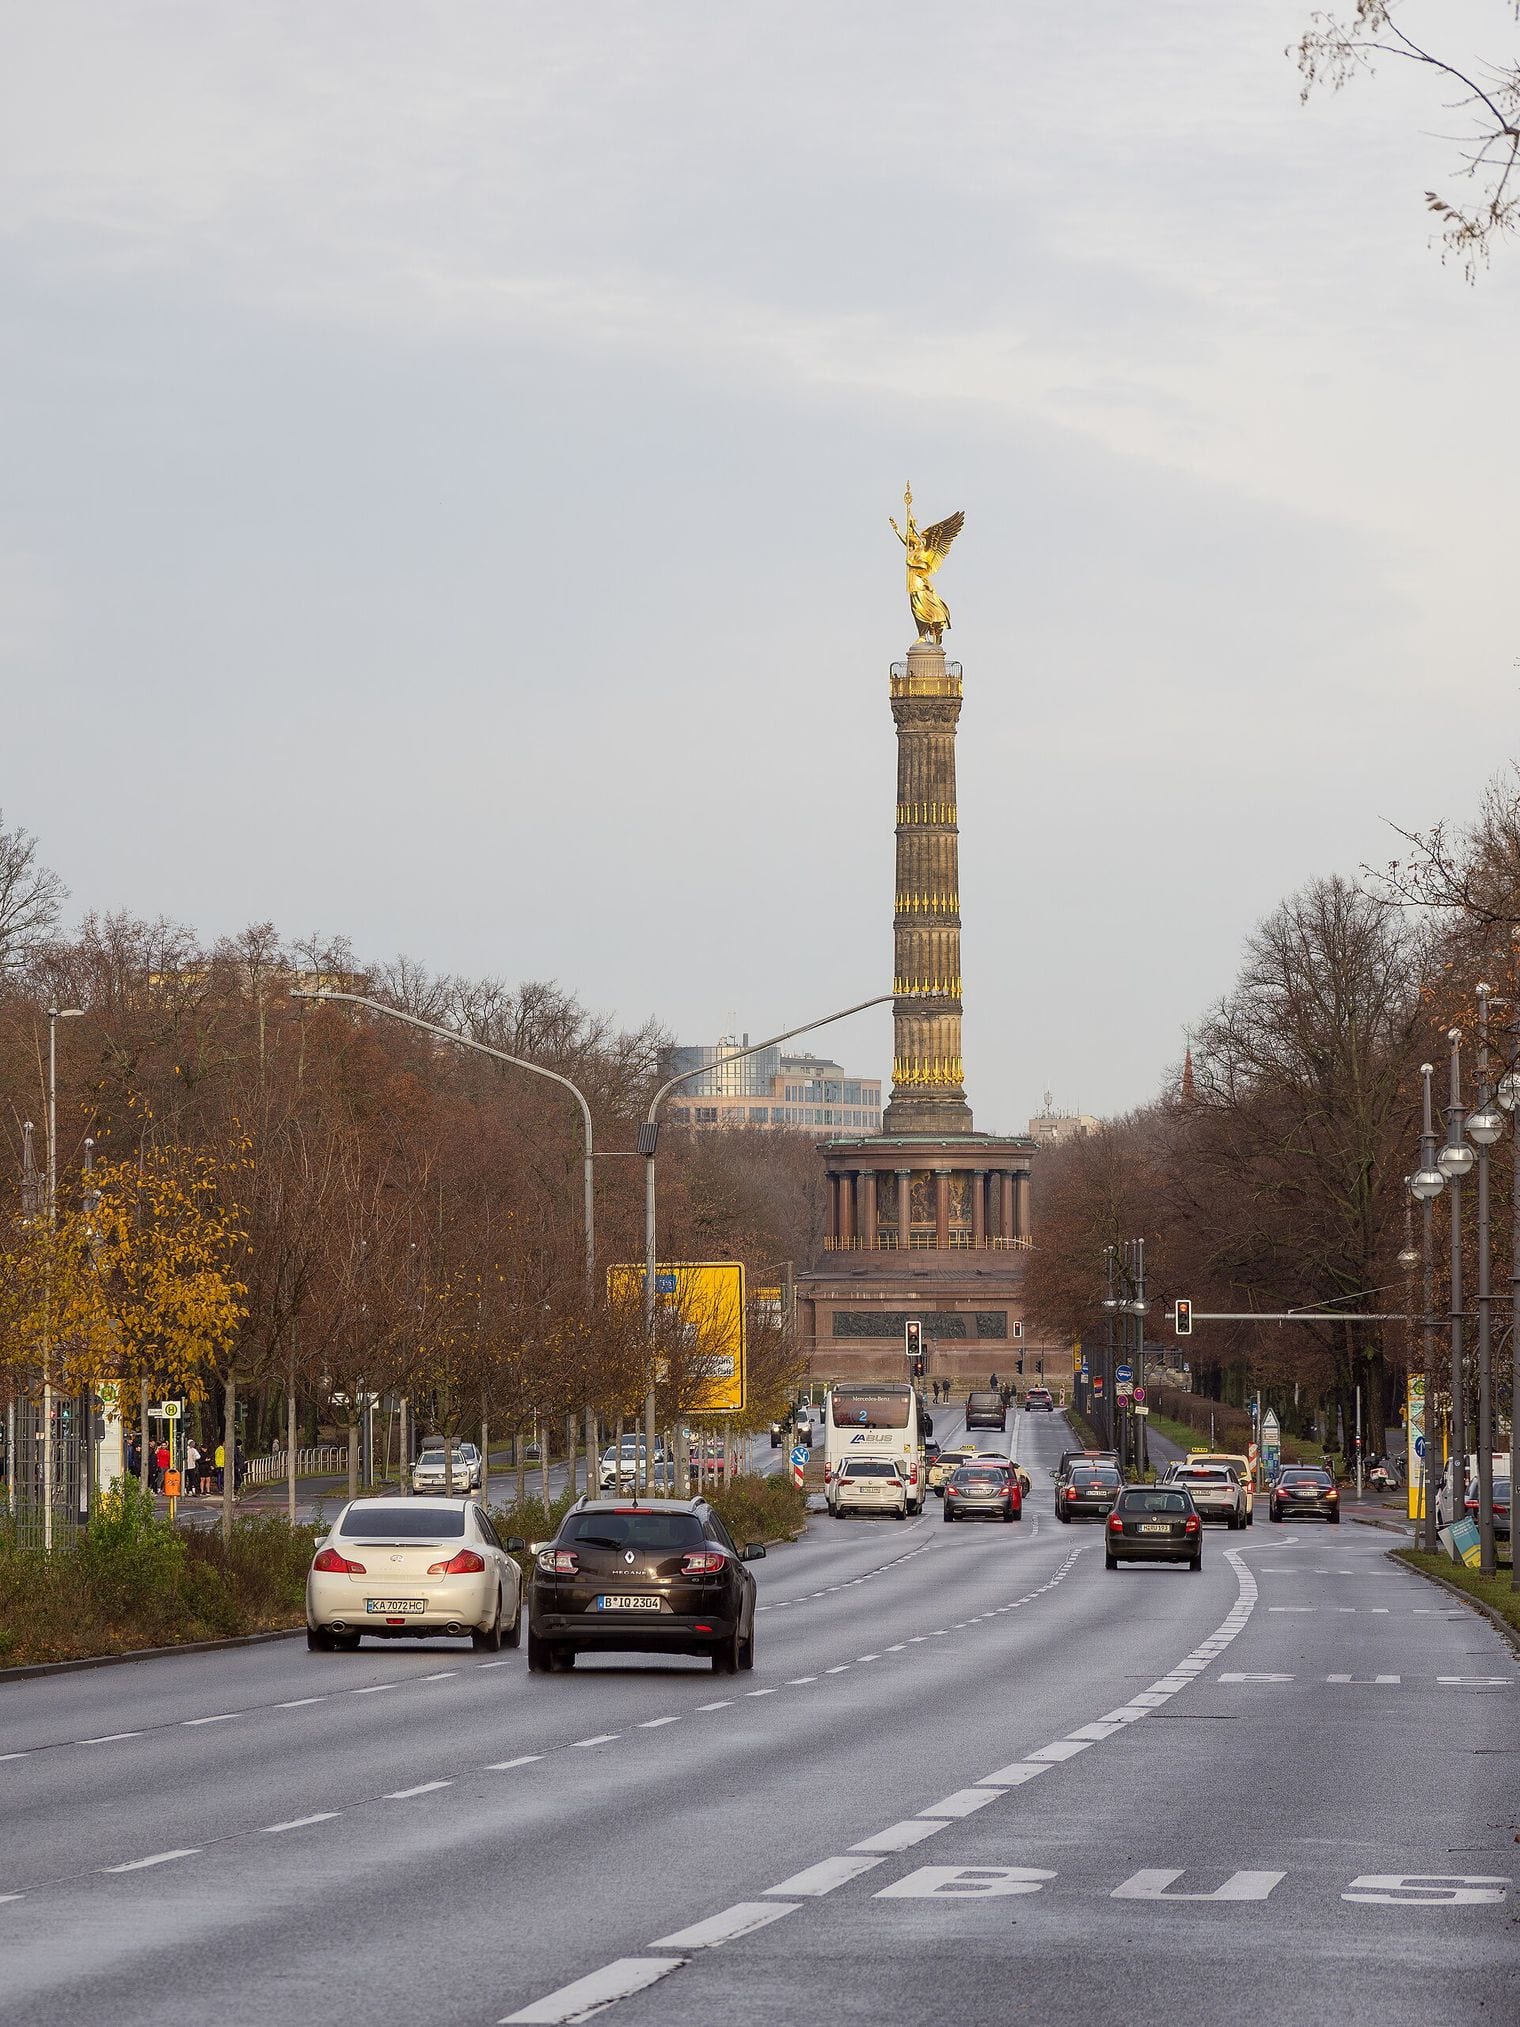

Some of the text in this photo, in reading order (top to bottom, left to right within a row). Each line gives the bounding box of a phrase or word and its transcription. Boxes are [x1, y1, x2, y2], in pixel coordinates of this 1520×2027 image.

[859, 1410, 868, 1422] 2
[387, 1601, 408, 1610] 7072
[633, 1598, 658, 1608] 2304
[871, 1866, 1512, 1905] BUS
